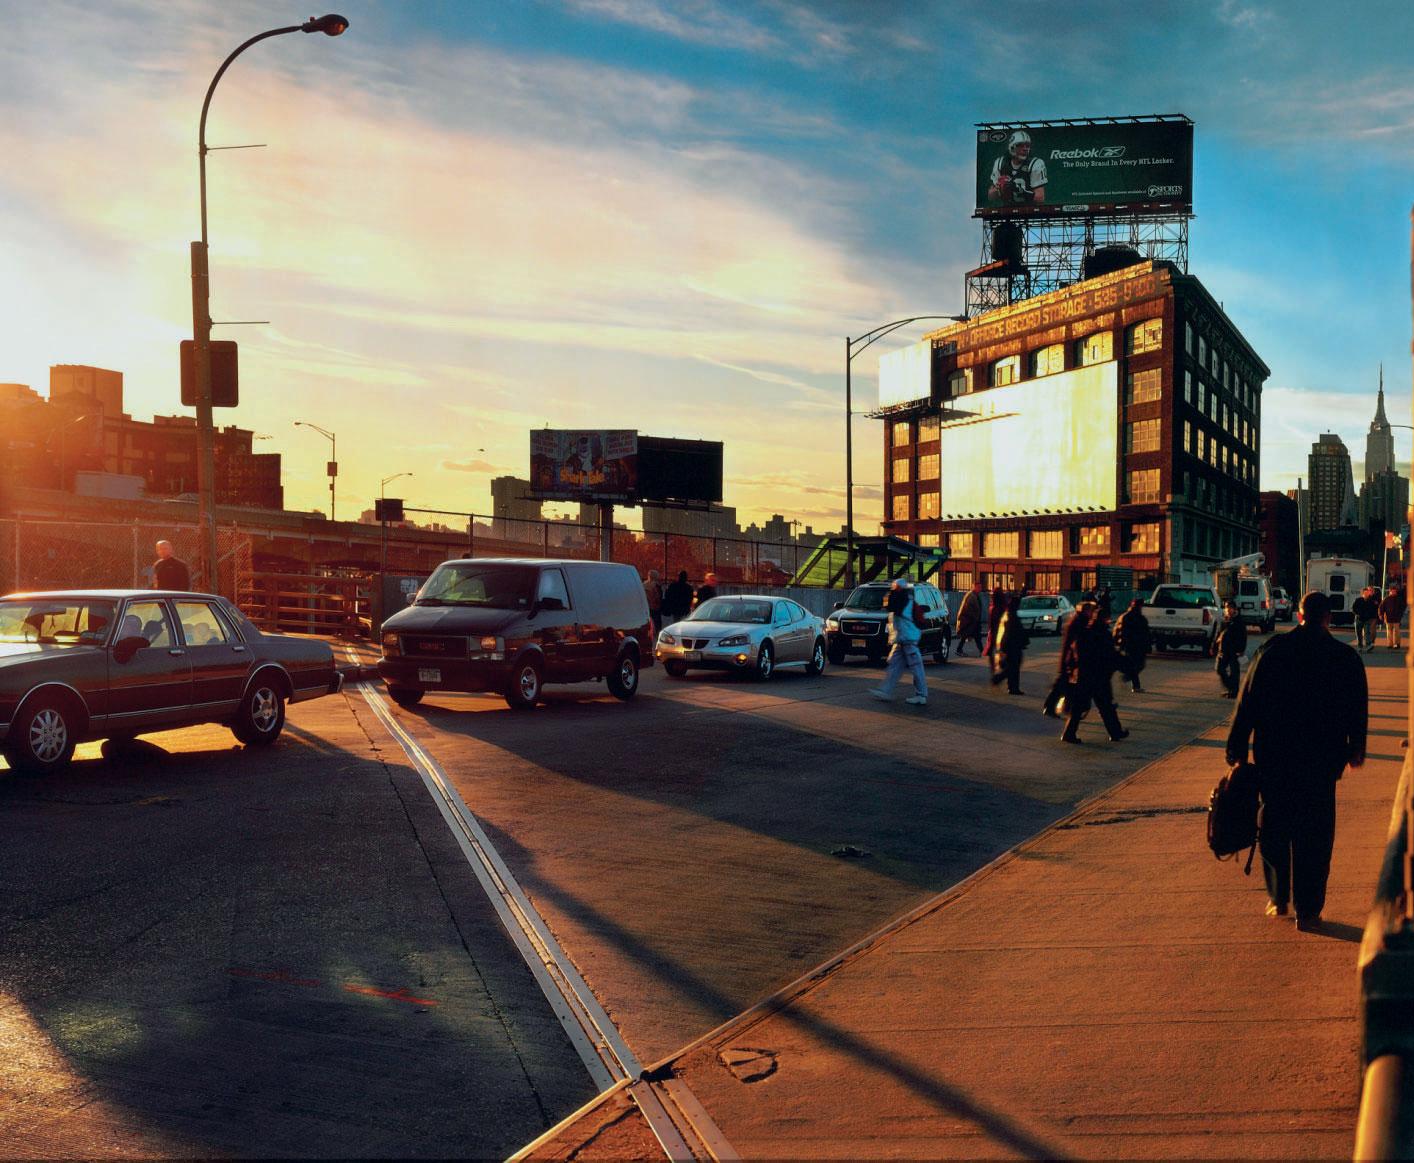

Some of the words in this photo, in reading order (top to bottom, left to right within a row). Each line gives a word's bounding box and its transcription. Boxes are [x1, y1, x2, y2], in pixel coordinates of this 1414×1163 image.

[1050, 148, 1099, 160] Reebok
[1075, 160, 1089, 169] Only
[1042, 294, 1087, 325] STORAGE
